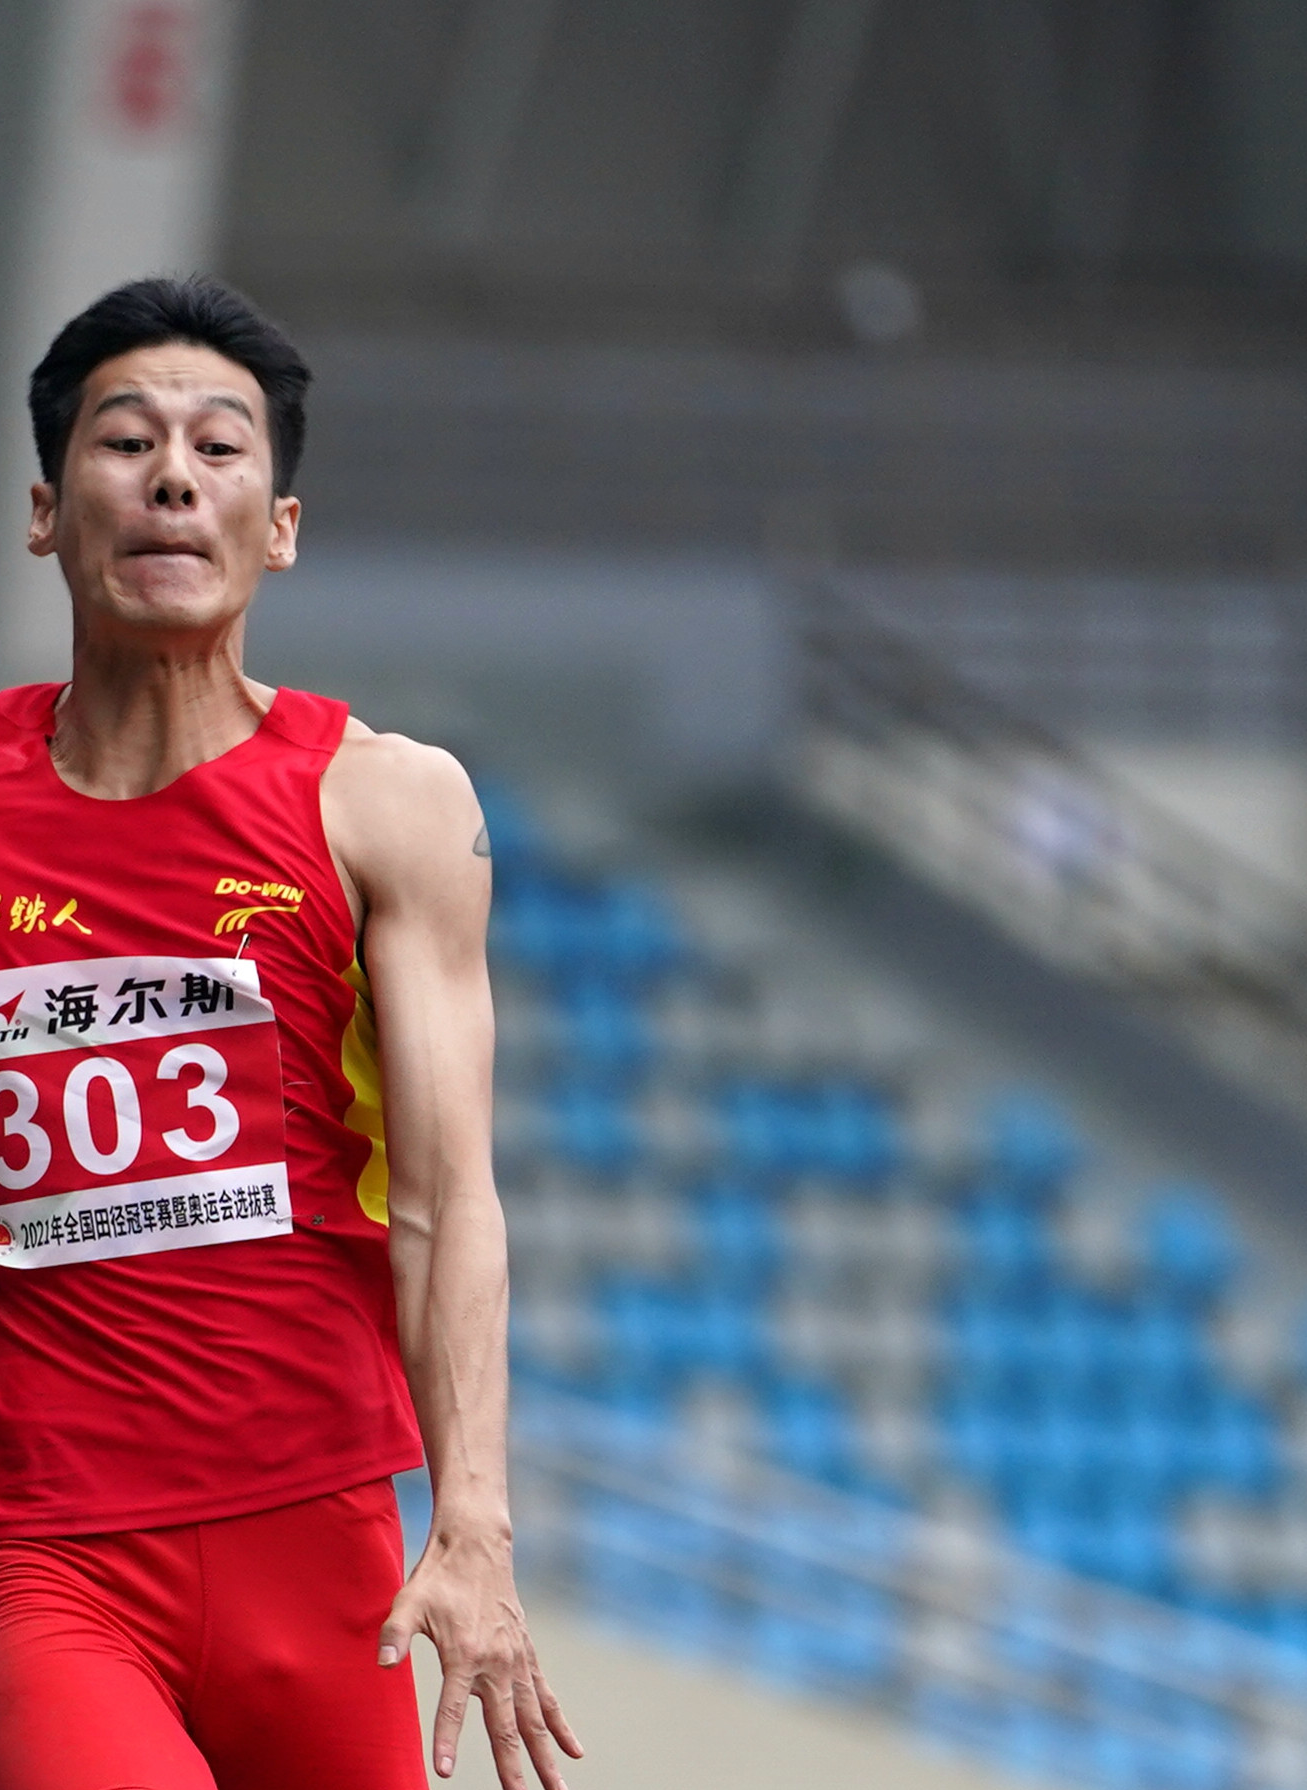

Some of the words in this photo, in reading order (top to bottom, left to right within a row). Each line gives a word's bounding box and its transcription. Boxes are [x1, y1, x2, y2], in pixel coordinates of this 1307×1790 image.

[45, 972, 235, 1036] 海尔斯
[20, 1184, 278, 1250] 2021年全国田径冠军赛暨奥运会选拔赛
